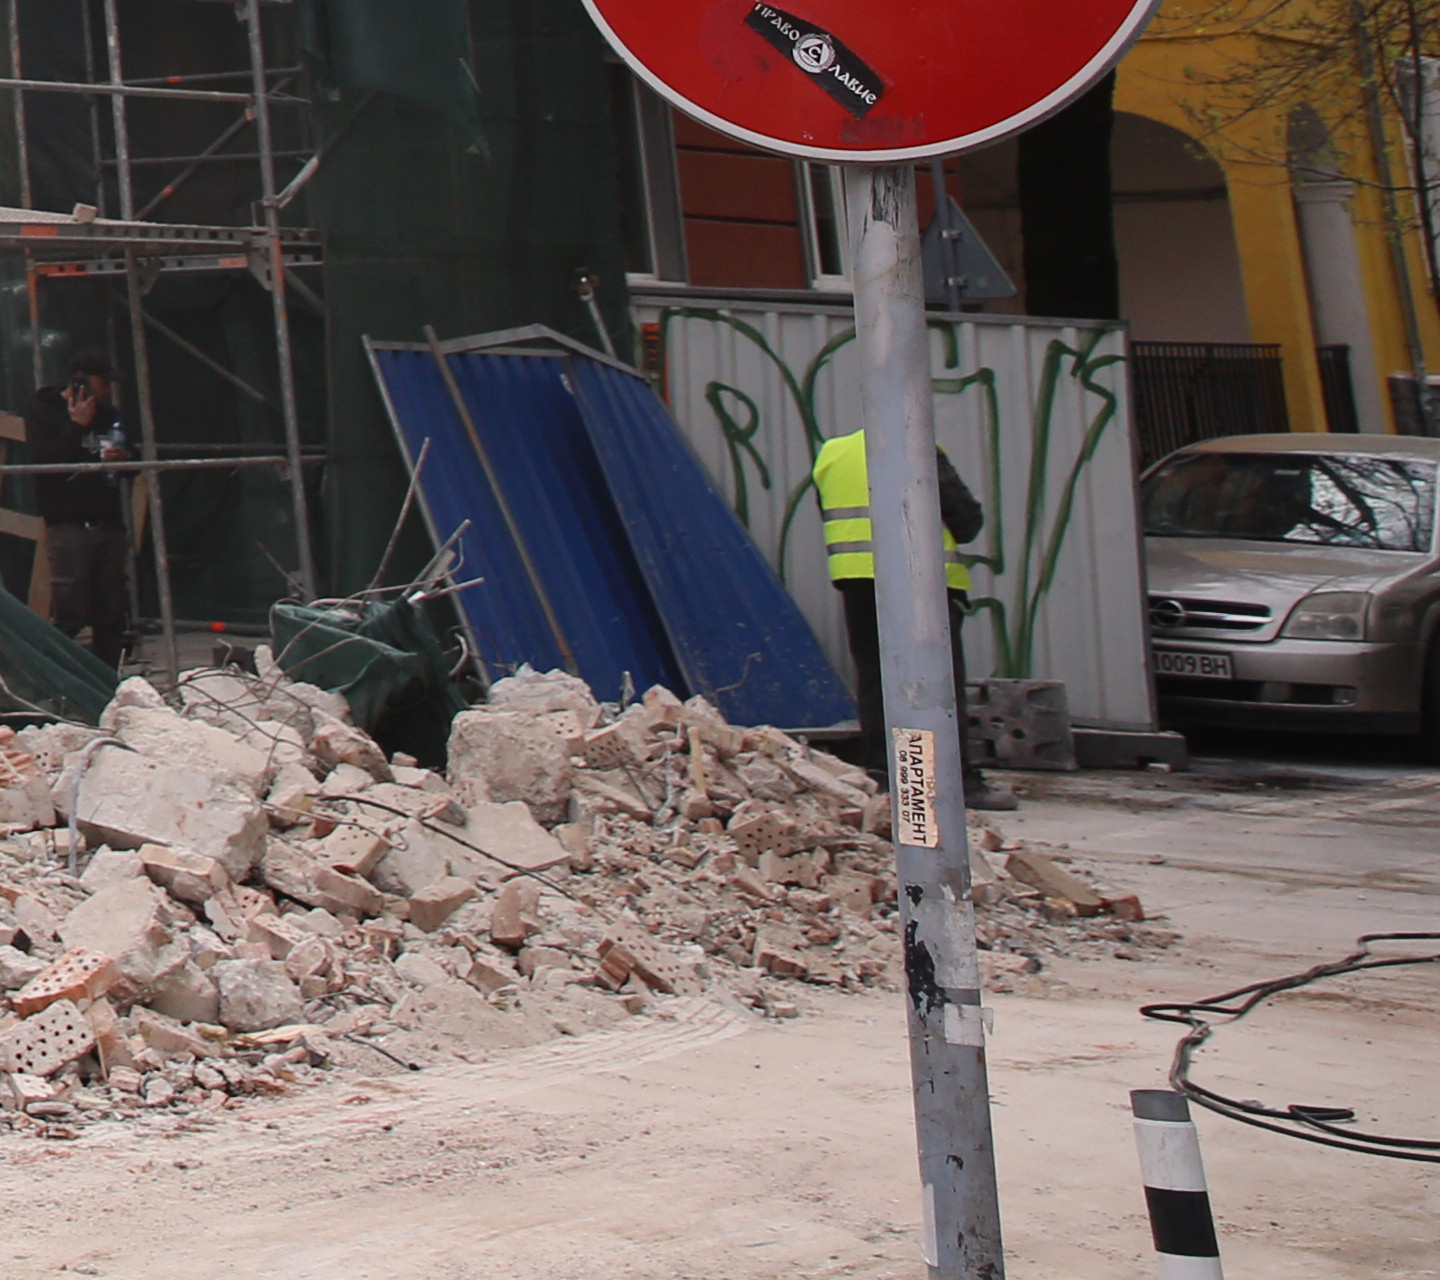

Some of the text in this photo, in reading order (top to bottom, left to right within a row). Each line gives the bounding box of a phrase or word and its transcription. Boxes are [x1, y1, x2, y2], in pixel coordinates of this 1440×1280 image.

[899, 750, 910, 823] 08 999 333 07
